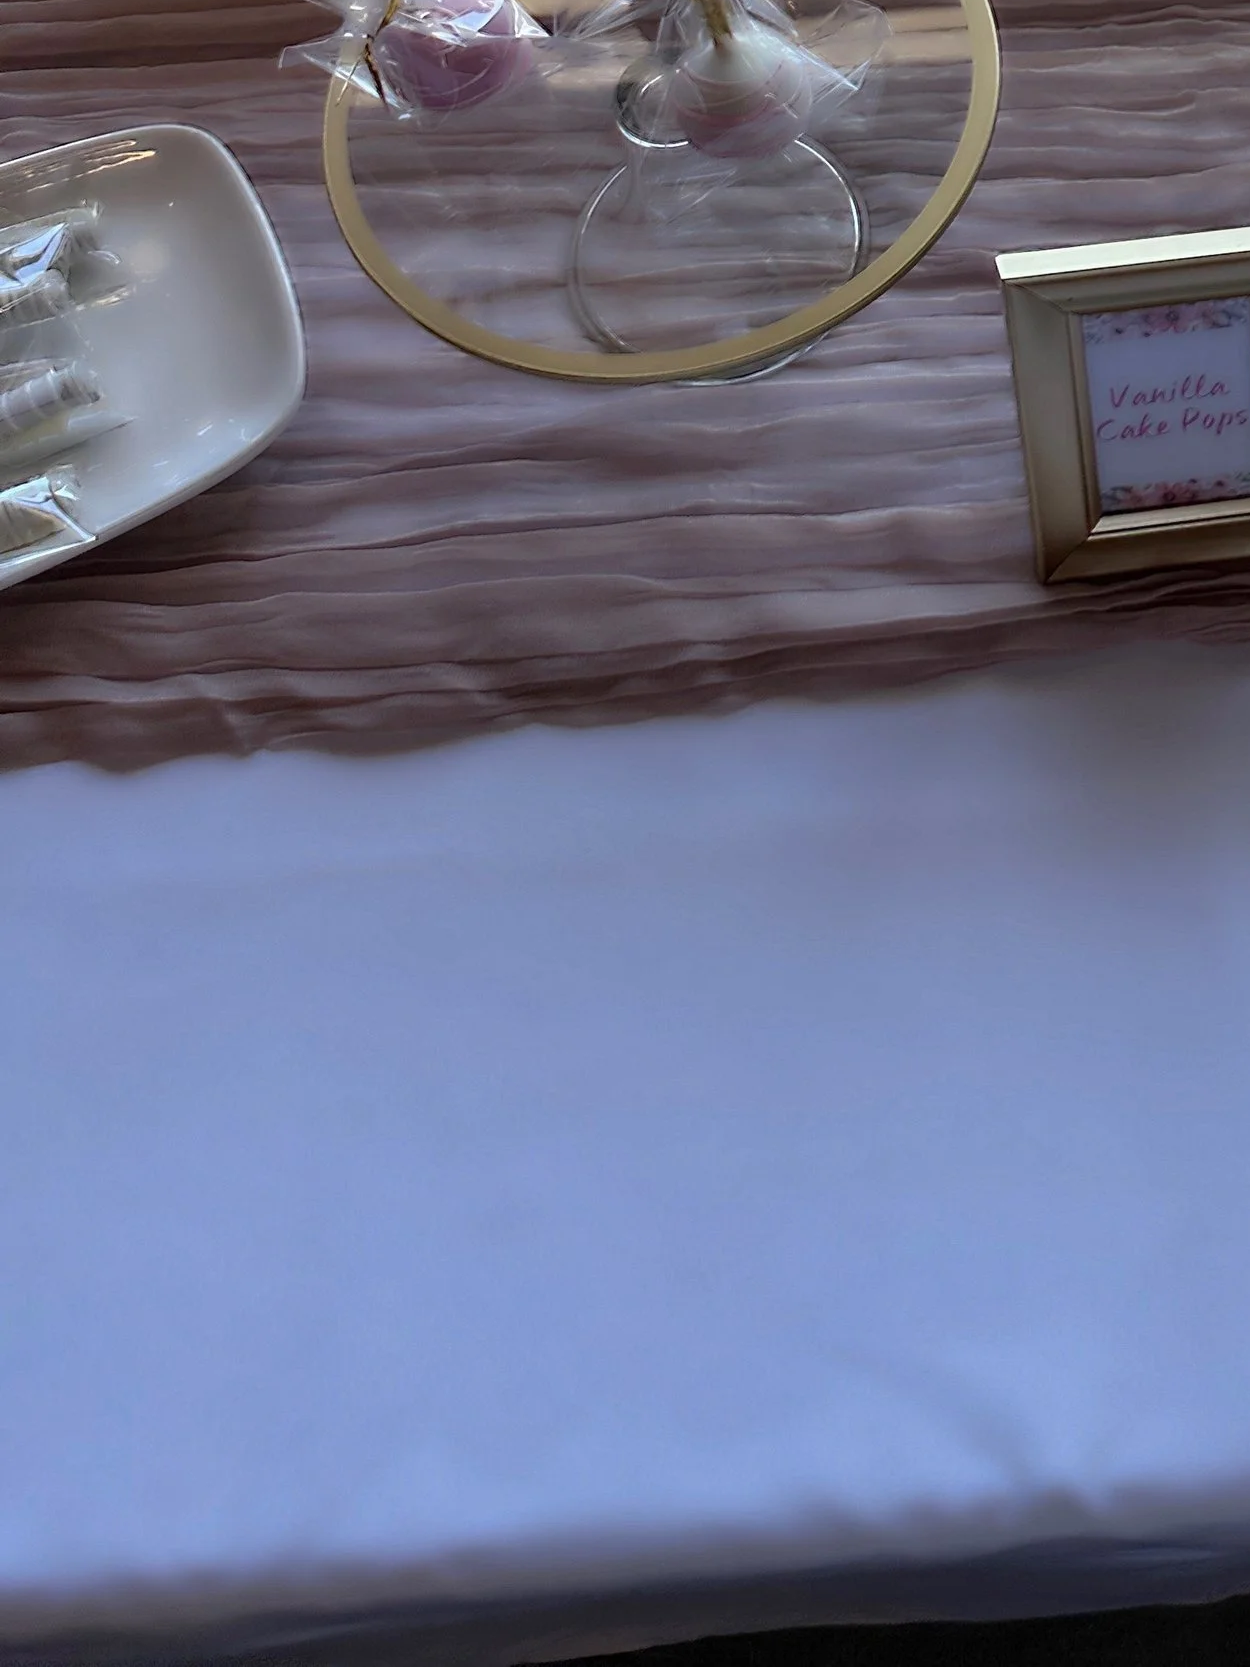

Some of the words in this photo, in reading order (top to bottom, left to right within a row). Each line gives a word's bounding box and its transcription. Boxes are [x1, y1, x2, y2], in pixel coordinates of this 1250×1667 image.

[1109, 374, 1231, 408] Vanilla
[1097, 413, 1170, 441] Cake
[1182, 406, 1248, 436] Pops
